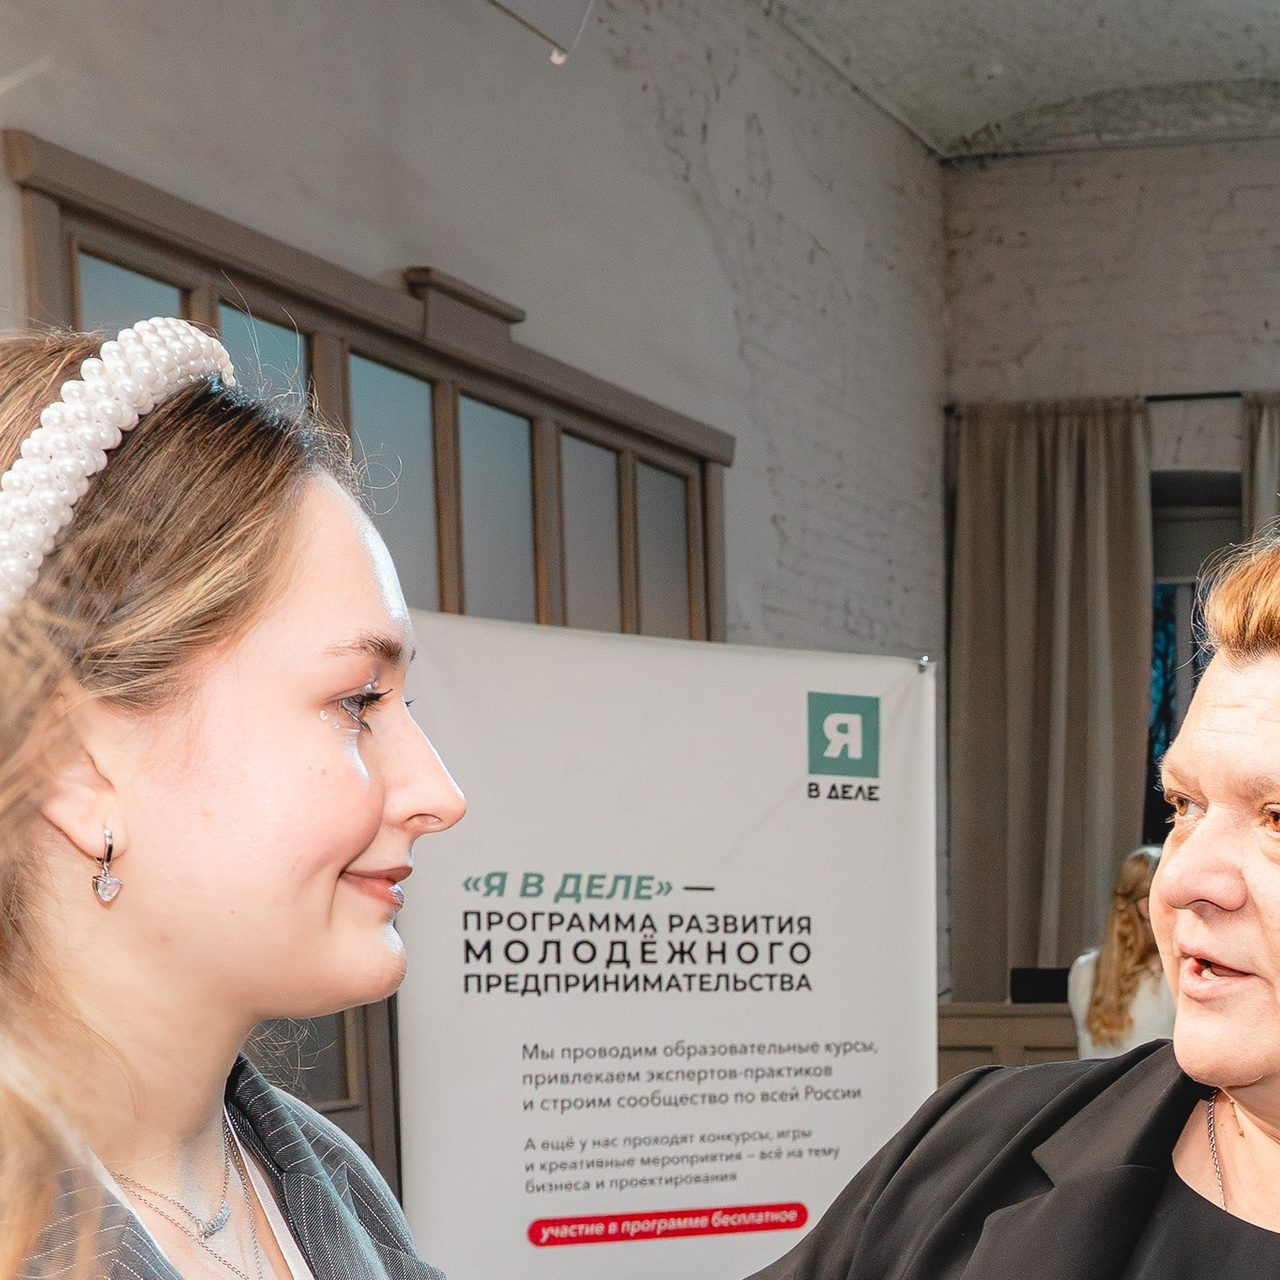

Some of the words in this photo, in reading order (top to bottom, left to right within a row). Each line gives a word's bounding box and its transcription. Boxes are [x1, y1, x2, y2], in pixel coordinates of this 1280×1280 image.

[823, 713, 862, 759] Я
[807, 782, 820, 799] В
[826, 783, 881, 801] ДЕЛЕ
[463, 872, 507, 898] «Я
[519, 873, 545, 898] В
[553, 874, 673, 903] ДЕЛЕ»
[463, 911, 657, 934] ПРОГРАММА
[668, 914, 813, 935] РАЗВИТИЯ
[464, 934, 813, 968] МОЛОДЁЖНОГО
[464, 973, 813, 996] ПРЕДПРИНИМАТЕЛЬСТВА
[522, 1043, 554, 1060] Мы
[561, 1045, 657, 1065] проводим
[663, 1039, 820, 1062] образовательные
[825, 1040, 879, 1058] курсы,
[522, 1069, 640, 1090] привлекаем
[646, 1065, 833, 1085] экспертов-практиков
[523, 1099, 534, 1111] и
[540, 1096, 611, 1114] строим
[617, 1089, 729, 1108] сообщество
[734, 1091, 756, 1104] по
[760, 1086, 799, 1102] всей
[804, 1085, 862, 1101] России
[524, 1137, 536, 1151] А
[541, 1136, 575, 1152] ещё
[579, 1139, 587, 1153] у
[592, 1137, 620, 1149] нас
[623, 1133, 695, 1150] проходят
[700, 1130, 773, 1147] конкурсы,
[776, 1129, 813, 1142] игры
[525, 1162, 534, 1172] и
[540, 1156, 635, 1175] креативные
[640, 1151, 742, 1168] мероприятия
[759, 1146, 783, 1160] всё
[787, 1148, 803, 1159] на
[808, 1147, 840, 1160] тему
[525, 1177, 590, 1194] бизнеса
[595, 1179, 605, 1189] и
[609, 1172, 737, 1191] проектирования
[540, 1221, 605, 1243] участие
[608, 1221, 618, 1234] в
[621, 1215, 709, 1236] программе
[711, 1209, 798, 1228] бесплатное
